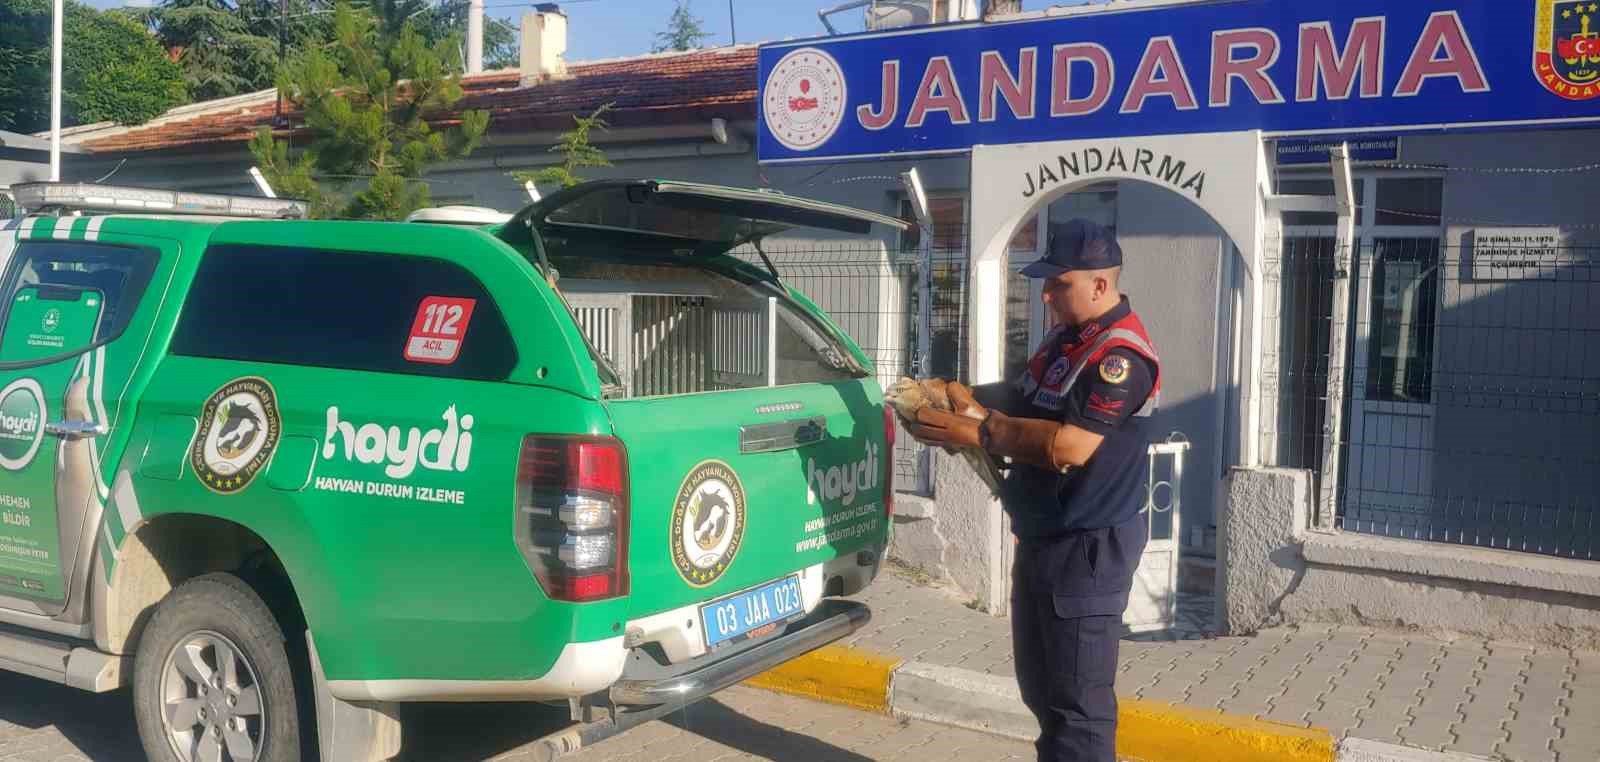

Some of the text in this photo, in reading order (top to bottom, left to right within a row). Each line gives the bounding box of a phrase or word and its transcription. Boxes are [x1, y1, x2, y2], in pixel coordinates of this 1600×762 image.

[857, 10, 1489, 130] JANDARMA
[1022, 147, 1206, 199] JANDARMA
[421, 303, 463, 335] 112
[322, 403, 474, 479] haydi
[315, 476, 364, 493] HAYVAN
[366, 480, 413, 499] DURUM
[807, 437, 879, 506] haydi
[716, 603, 738, 635] 03
[745, 592, 771, 626] JAA
[774, 582, 800, 614] 023
